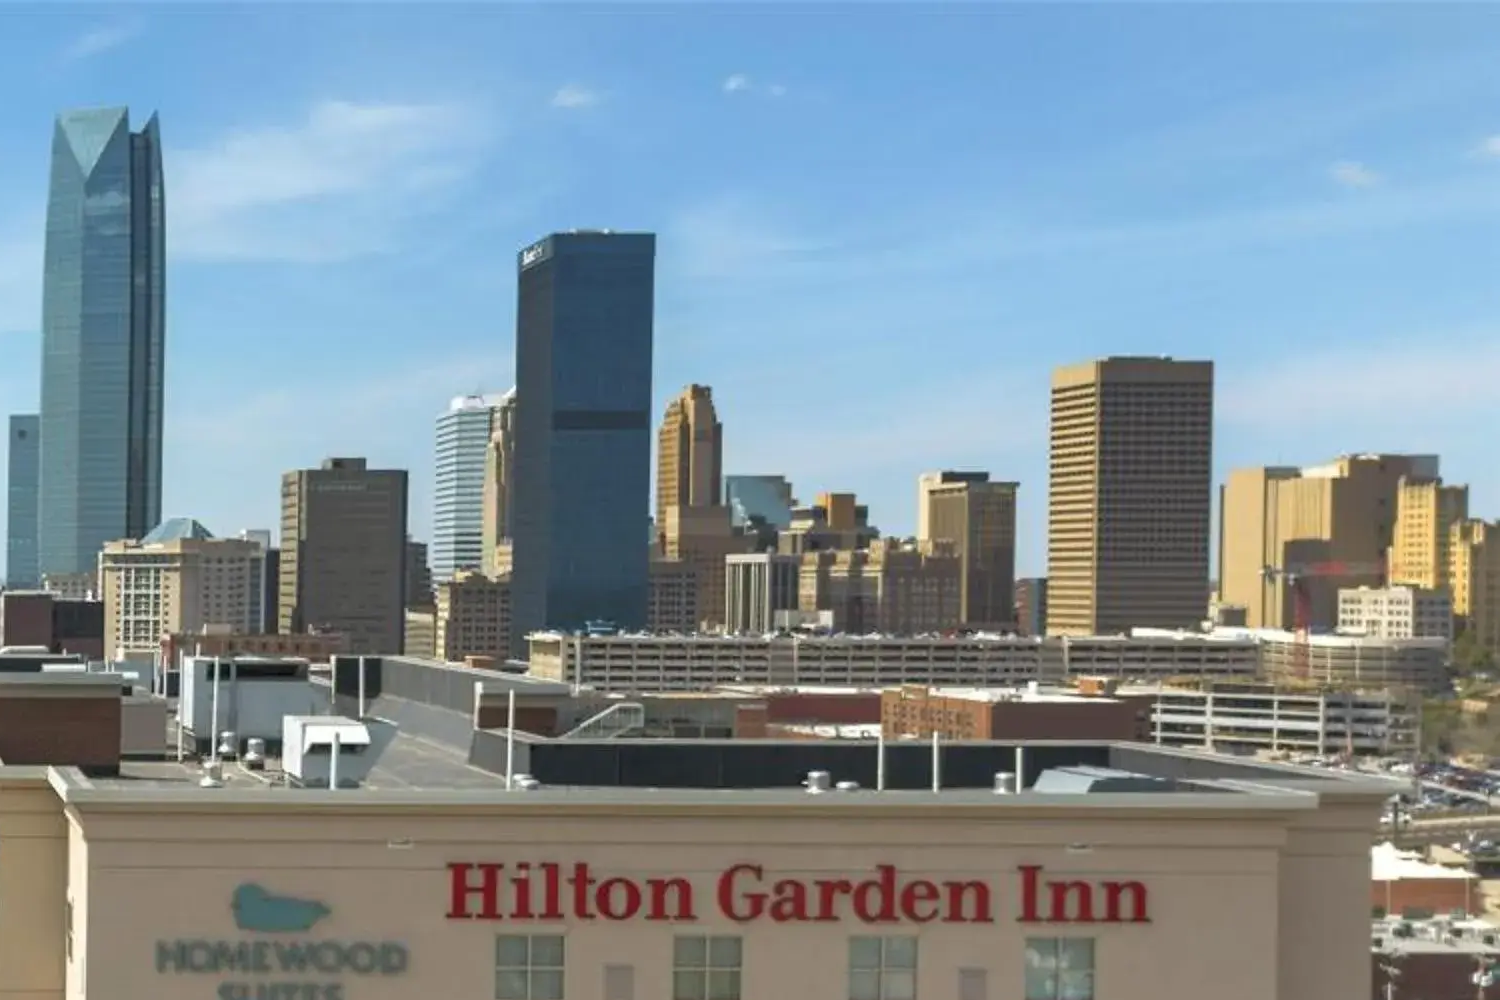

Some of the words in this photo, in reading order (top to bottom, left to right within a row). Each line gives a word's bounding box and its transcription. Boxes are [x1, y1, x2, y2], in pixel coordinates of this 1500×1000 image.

[445, 862, 698, 920] Hilton
[717, 863, 995, 923] Garden
[1015, 864, 1153, 923] Inn
[155, 940, 409, 974] HOMEWOOD
